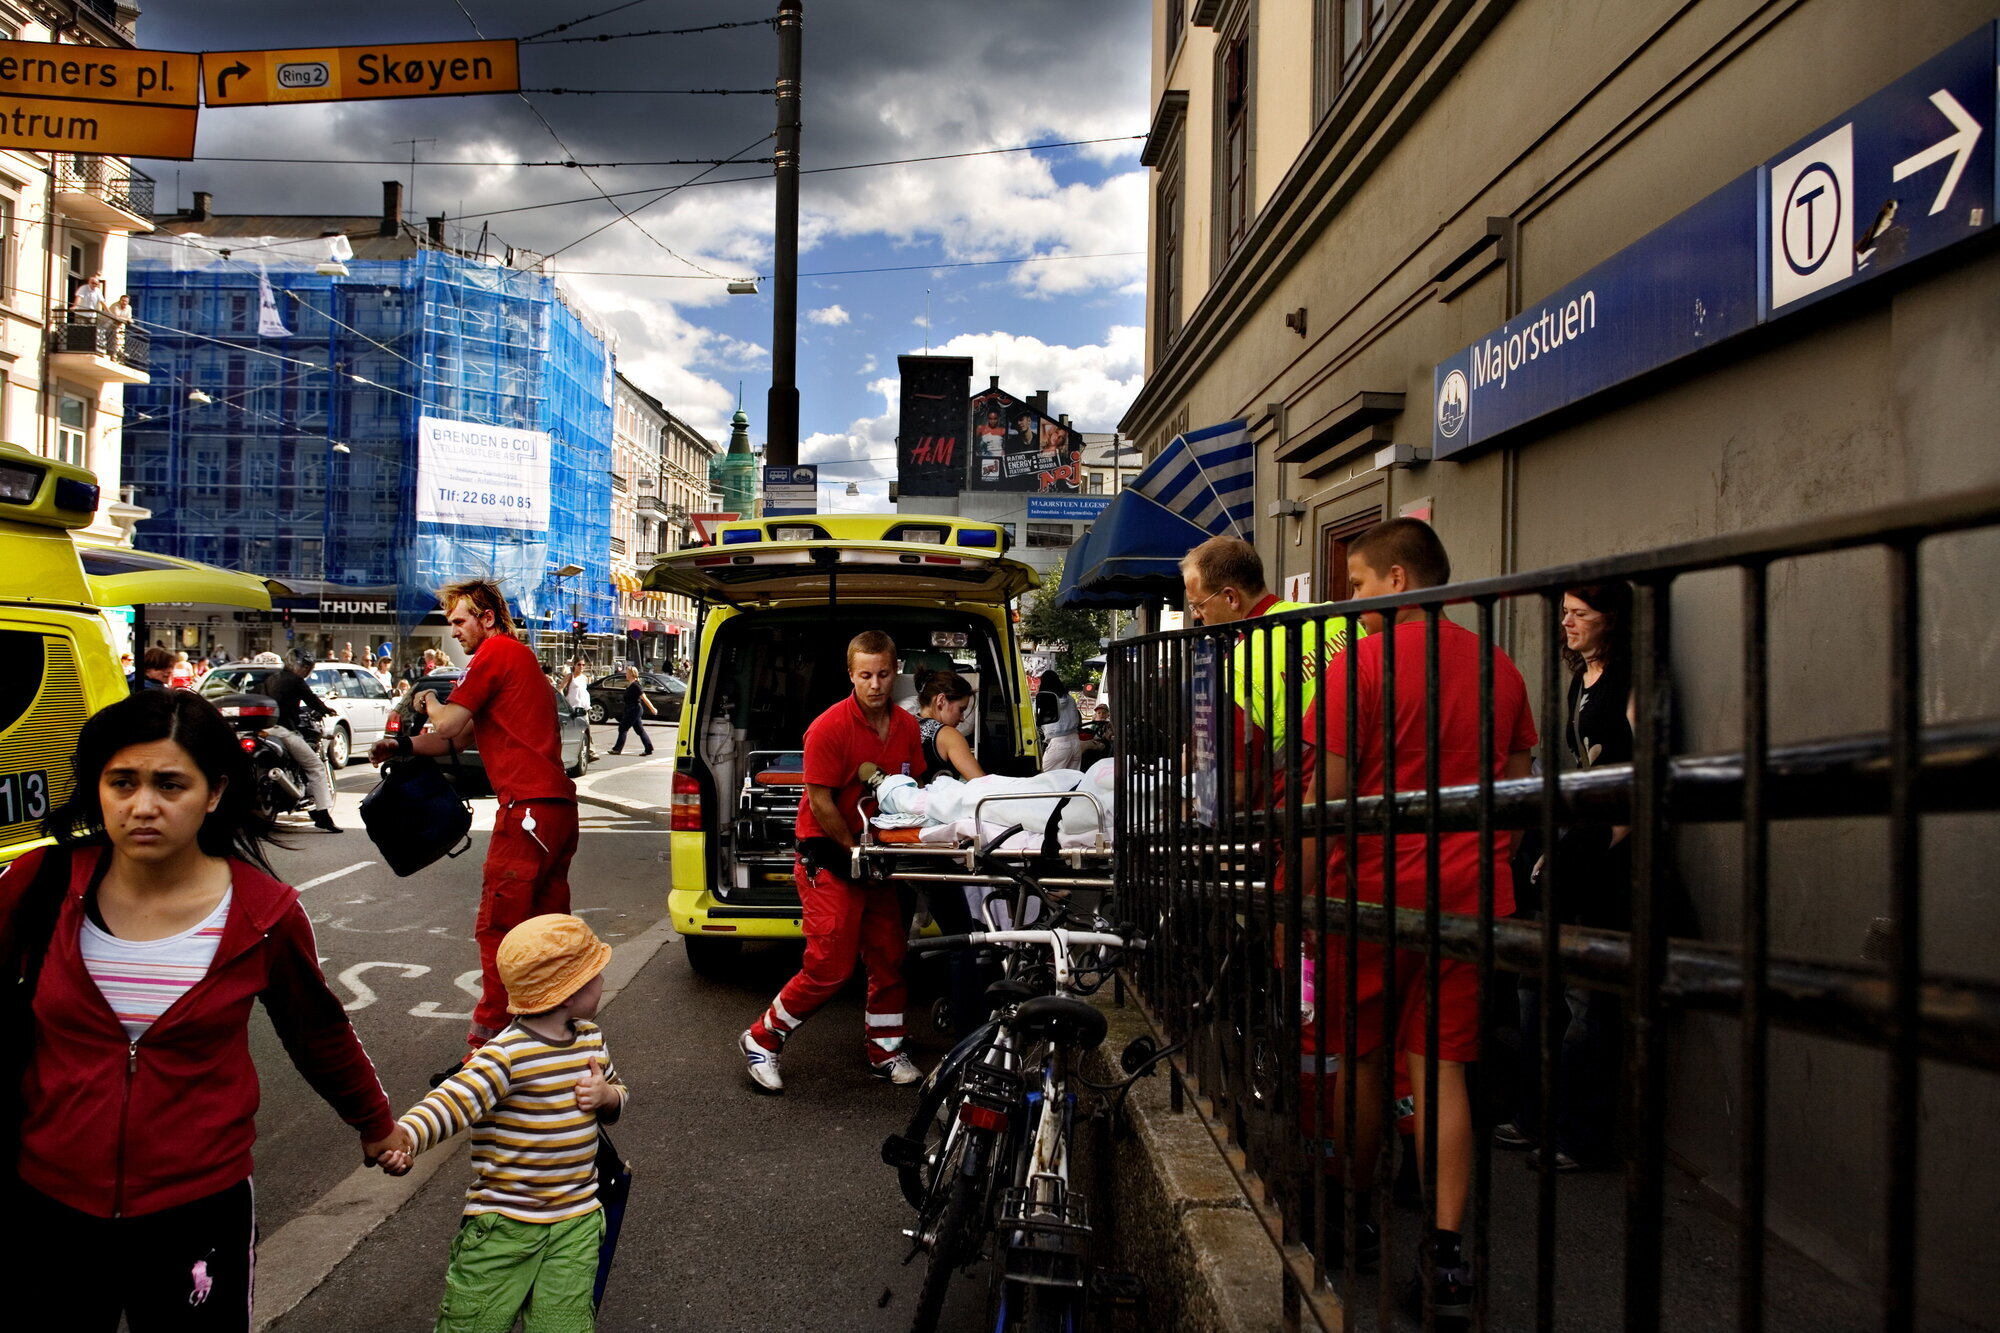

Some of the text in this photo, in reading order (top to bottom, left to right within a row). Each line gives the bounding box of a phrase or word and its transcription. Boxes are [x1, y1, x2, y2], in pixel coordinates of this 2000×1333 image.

[137, 60, 175, 97] pl.
[283, 68, 323, 84] Ring 2
[357, 53, 493, 91] Skøyen
[1796, 184, 1825, 260] T
[1473, 290, 1596, 390] Majorstuen
[433, 428, 530, 452] BRENDEN & CO
[911, 437, 956, 465] H&M
[1006, 454, 1026, 462] RADIO
[1007, 459, 1032, 469] ENERGY
[438, 488, 531, 509] Tlf: 22 68 40 85
[1031, 500, 1078, 508] MAJORSTUEN
[320, 601, 388, 614] THUNE
